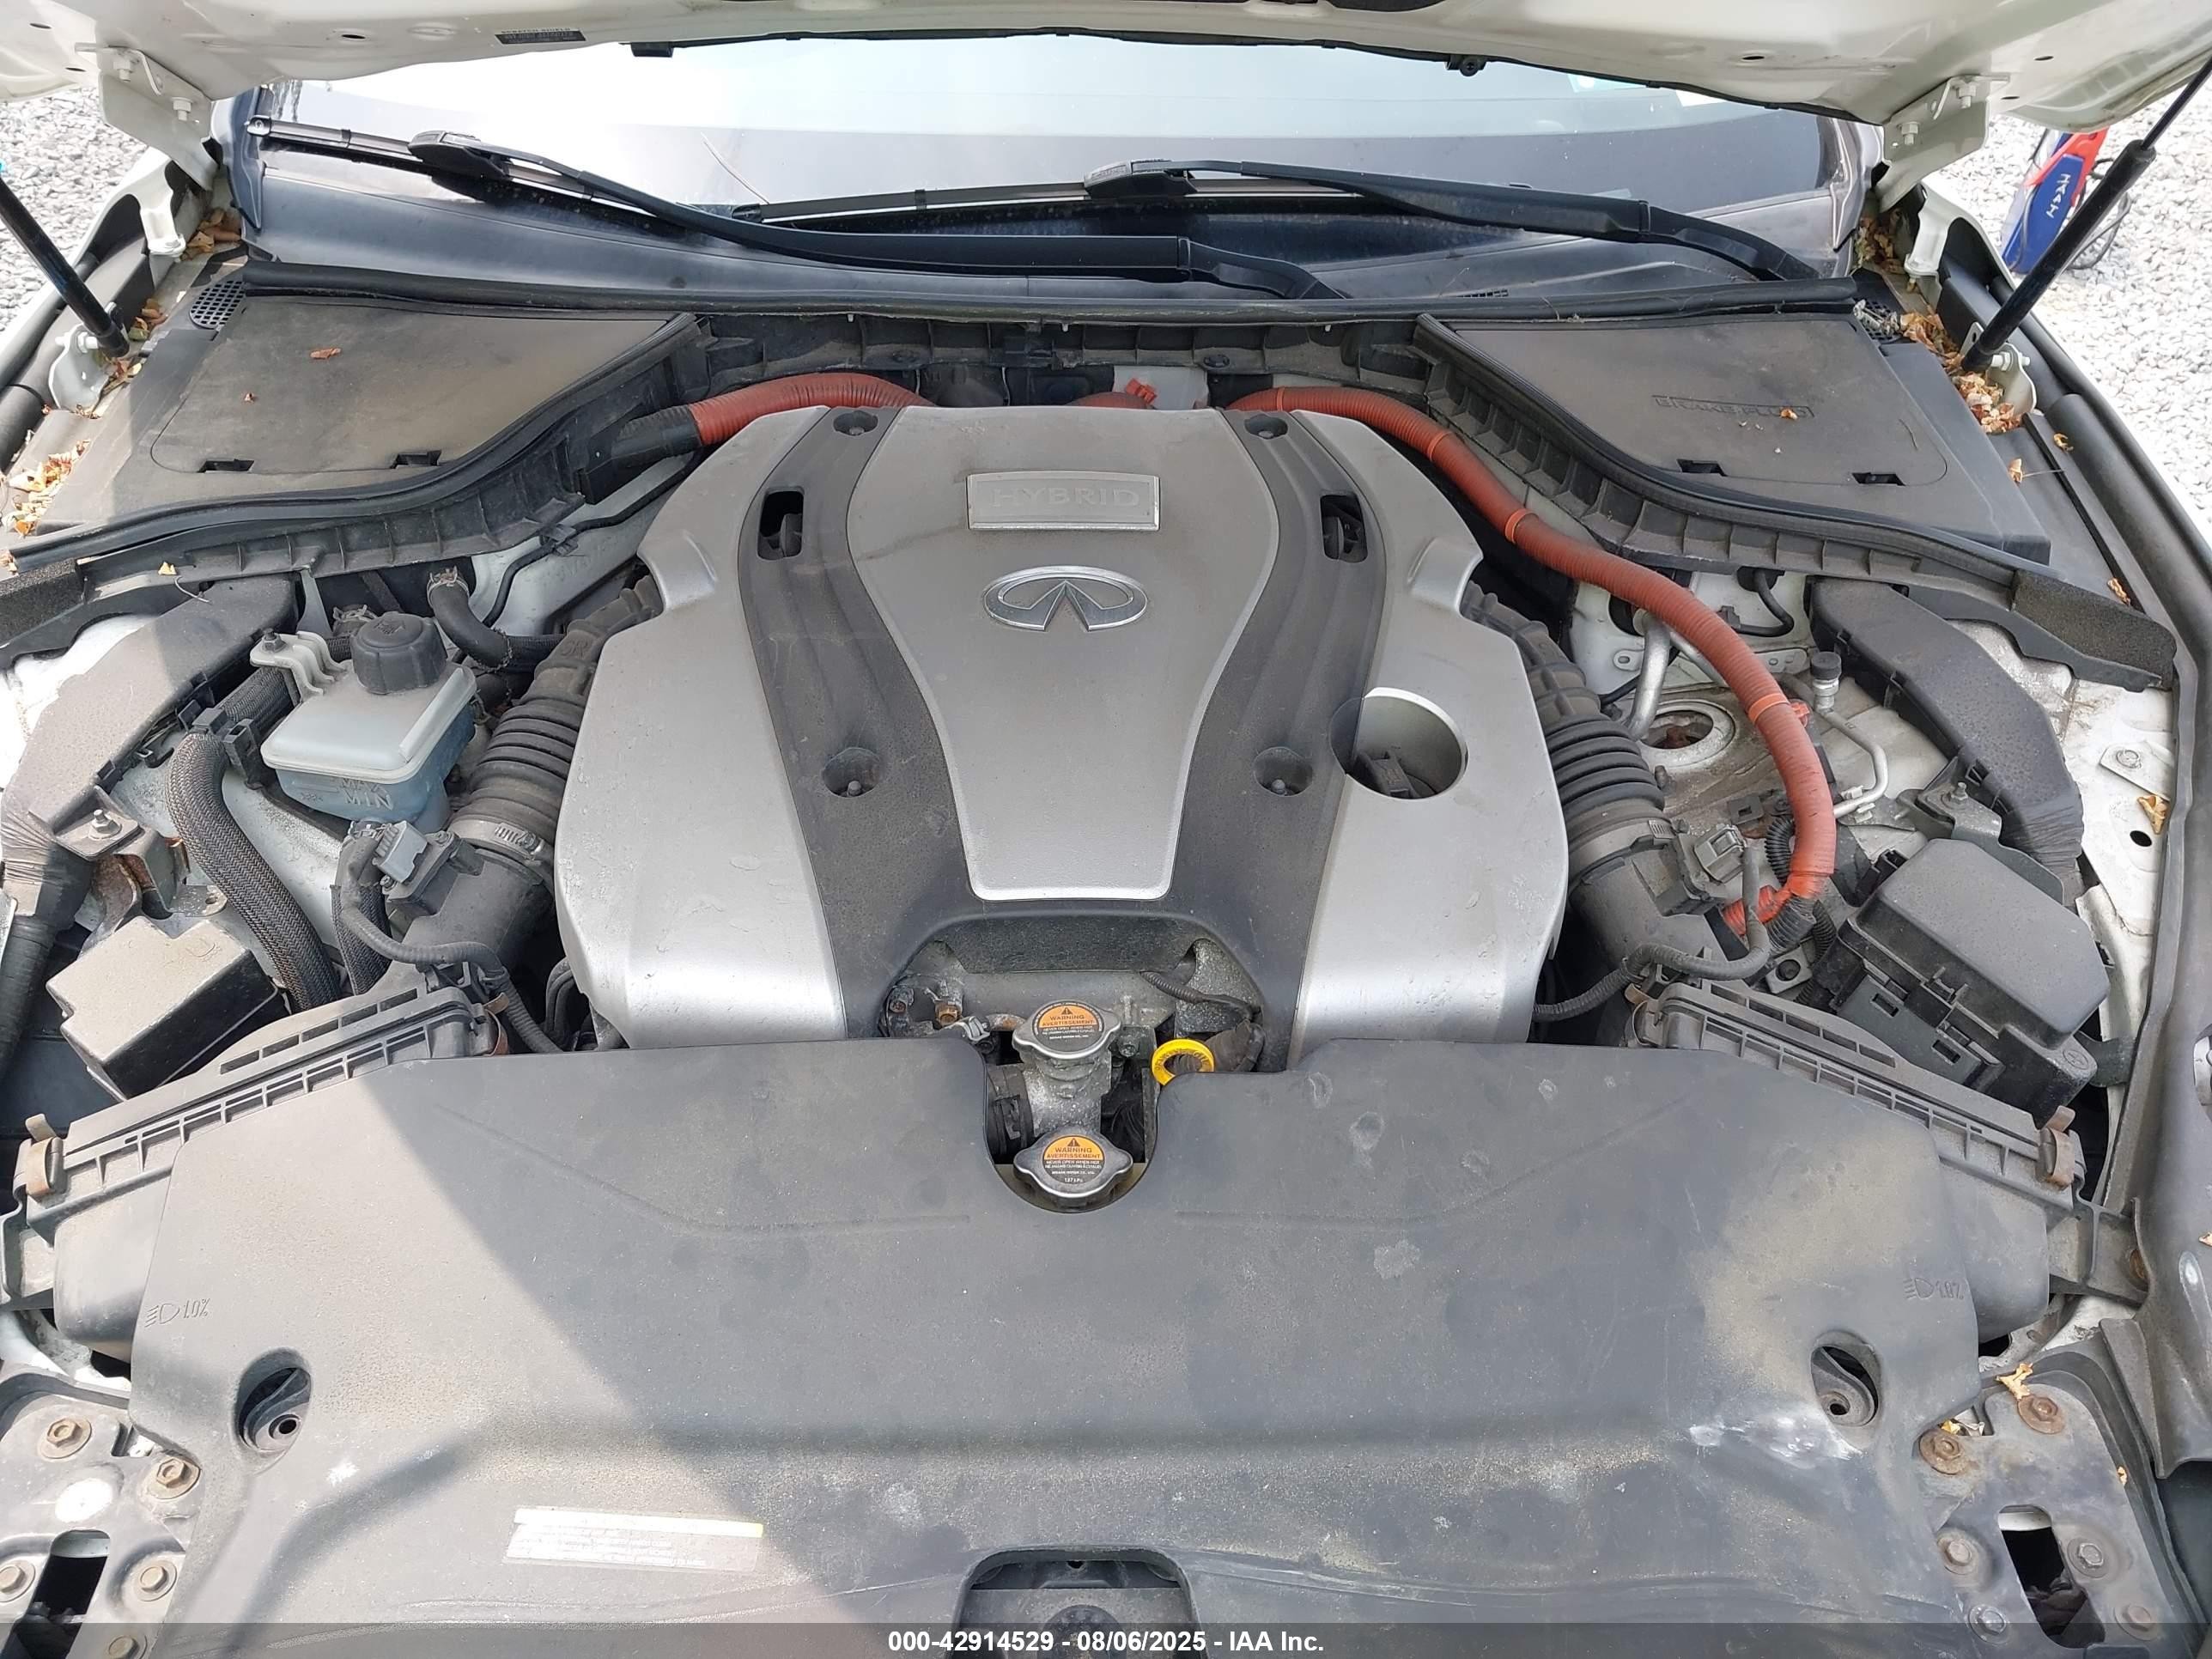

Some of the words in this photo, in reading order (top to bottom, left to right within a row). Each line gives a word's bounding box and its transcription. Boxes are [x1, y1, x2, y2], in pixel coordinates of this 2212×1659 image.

[1741, 404, 1809, 420] FLUD
[992, 486, 1140, 507] HYBRID
[343, 790, 394, 811] MIN
